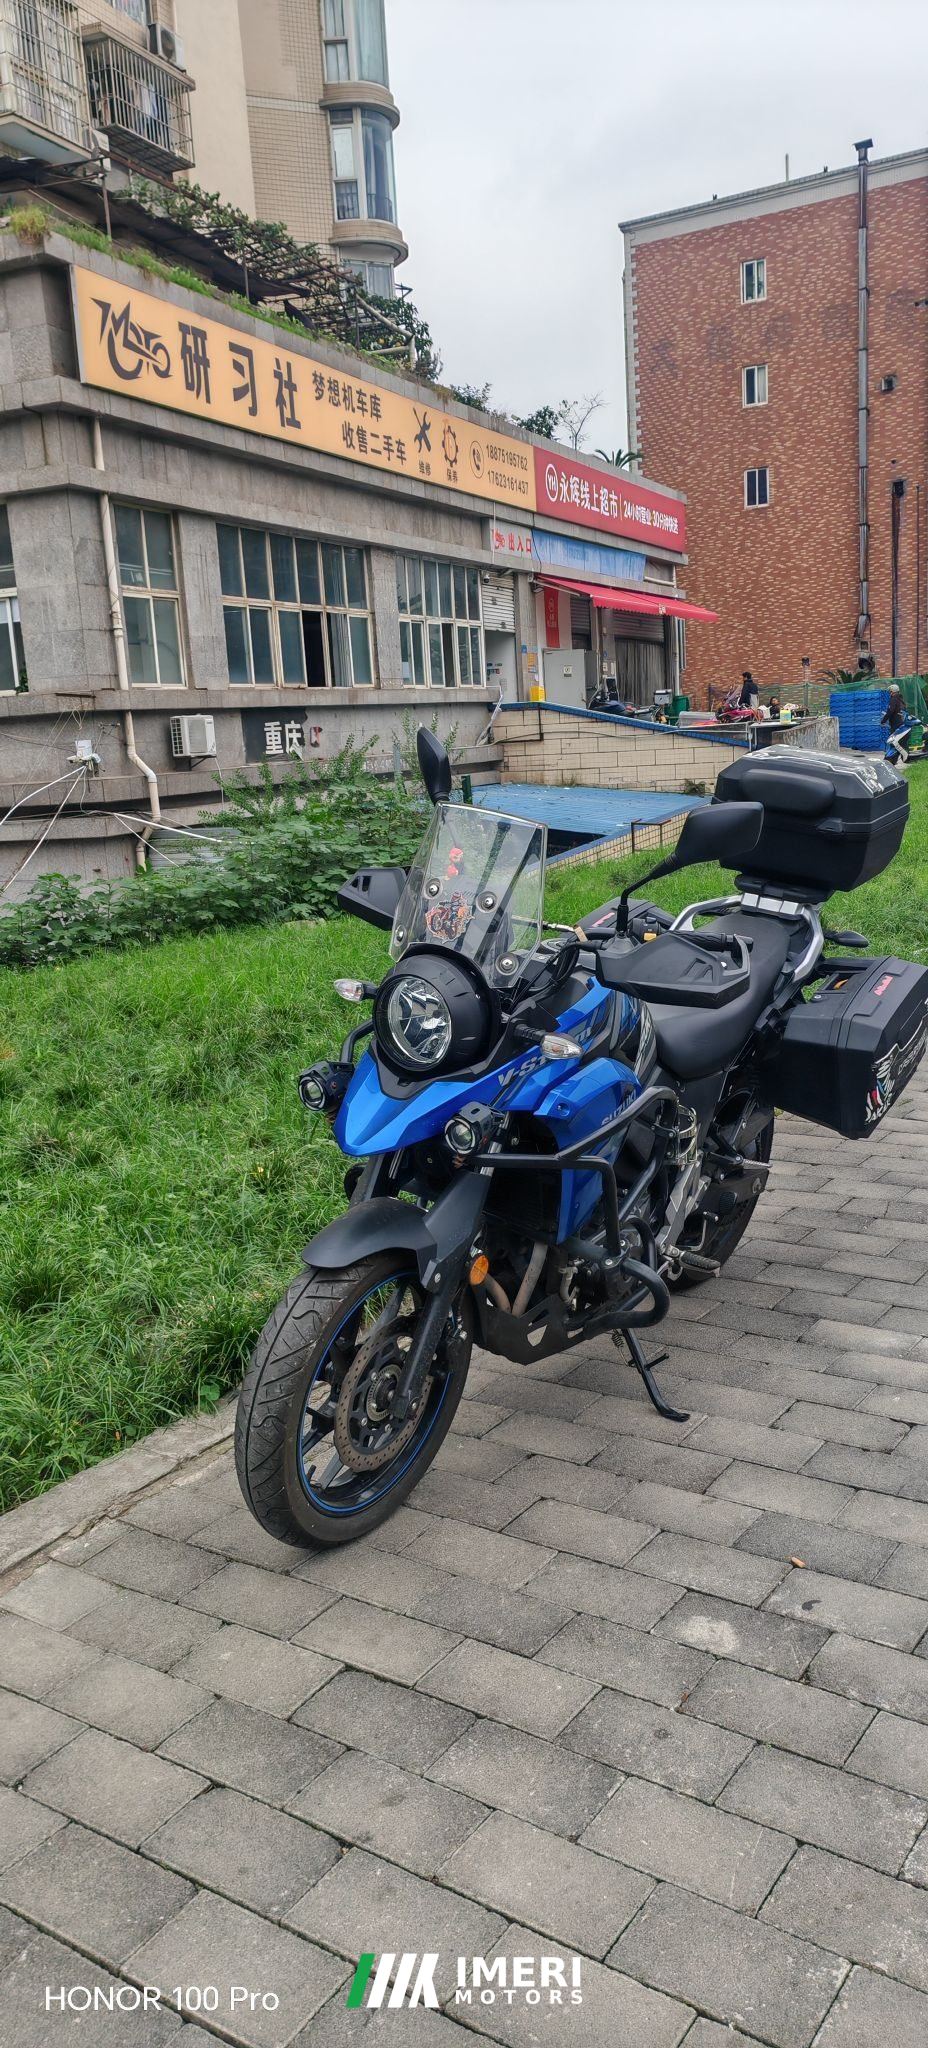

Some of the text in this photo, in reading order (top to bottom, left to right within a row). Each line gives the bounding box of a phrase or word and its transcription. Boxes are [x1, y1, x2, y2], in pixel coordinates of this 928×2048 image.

[178, 321, 302, 430] 研习社
[311, 370, 382, 423] 梦想机车库
[341, 420, 407, 466] 收售二手车
[559, 471, 618, 519] 永辉线上超市
[508, 532, 532, 553] 出入口
[264, 720, 304, 761] 重庆
